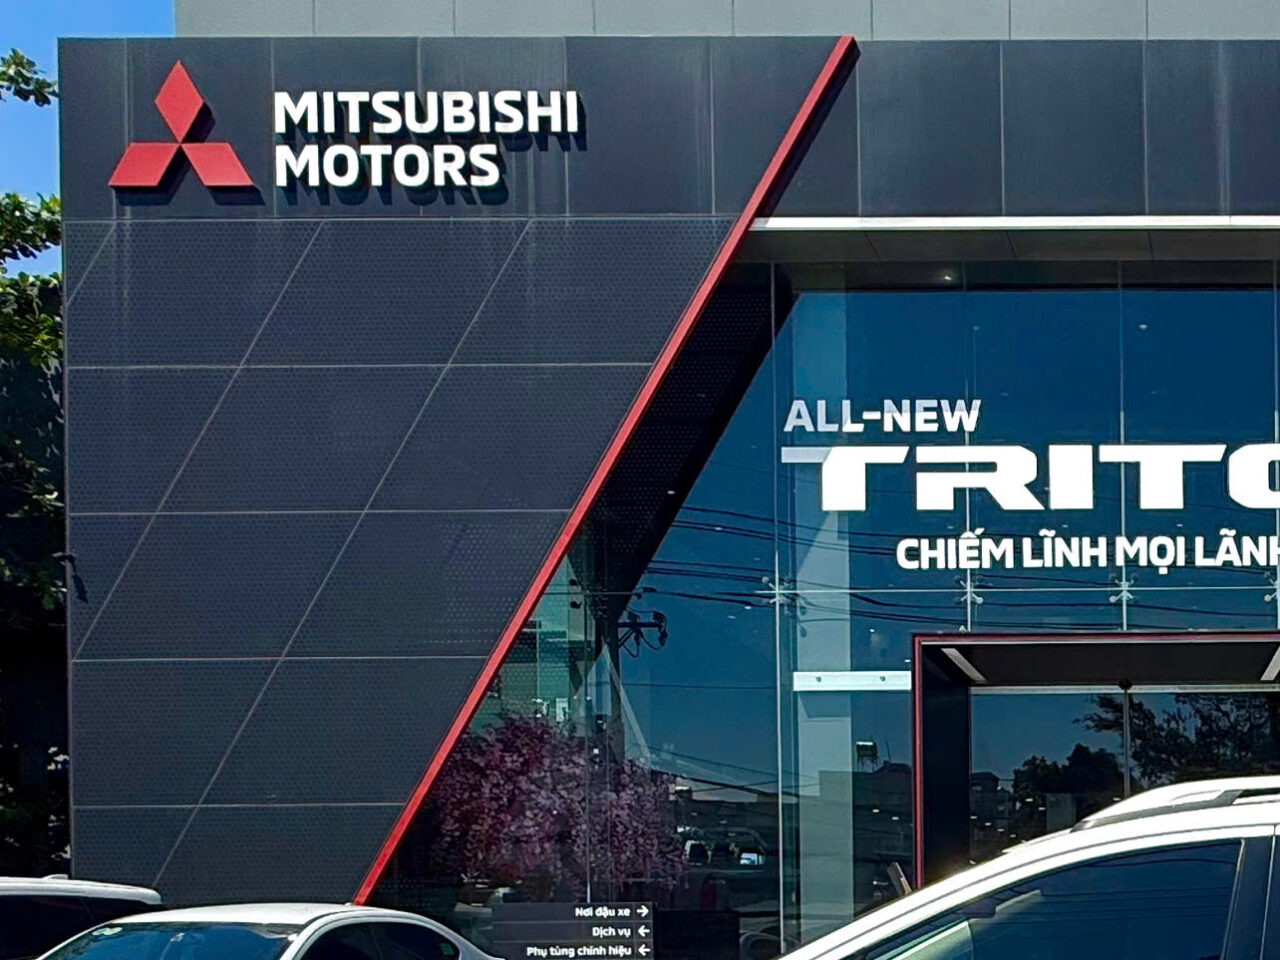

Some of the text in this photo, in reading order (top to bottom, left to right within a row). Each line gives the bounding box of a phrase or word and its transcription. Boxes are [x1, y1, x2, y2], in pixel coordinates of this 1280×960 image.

[274, 90, 579, 133] MITSUBISHI
[275, 144, 500, 187] MOTORS
[784, 399, 981, 432] ALL-NEW
[896, 527, 1015, 569] CHIẾM
[1022, 529, 1107, 567] LĨNH
[1116, 535, 1186, 574] MỌI
[617, 908, 631, 917] xe
[592, 927, 631, 938] Dịch vụ
[526, 947, 548, 958] Phụ
[549, 946, 575, 958] tùng
